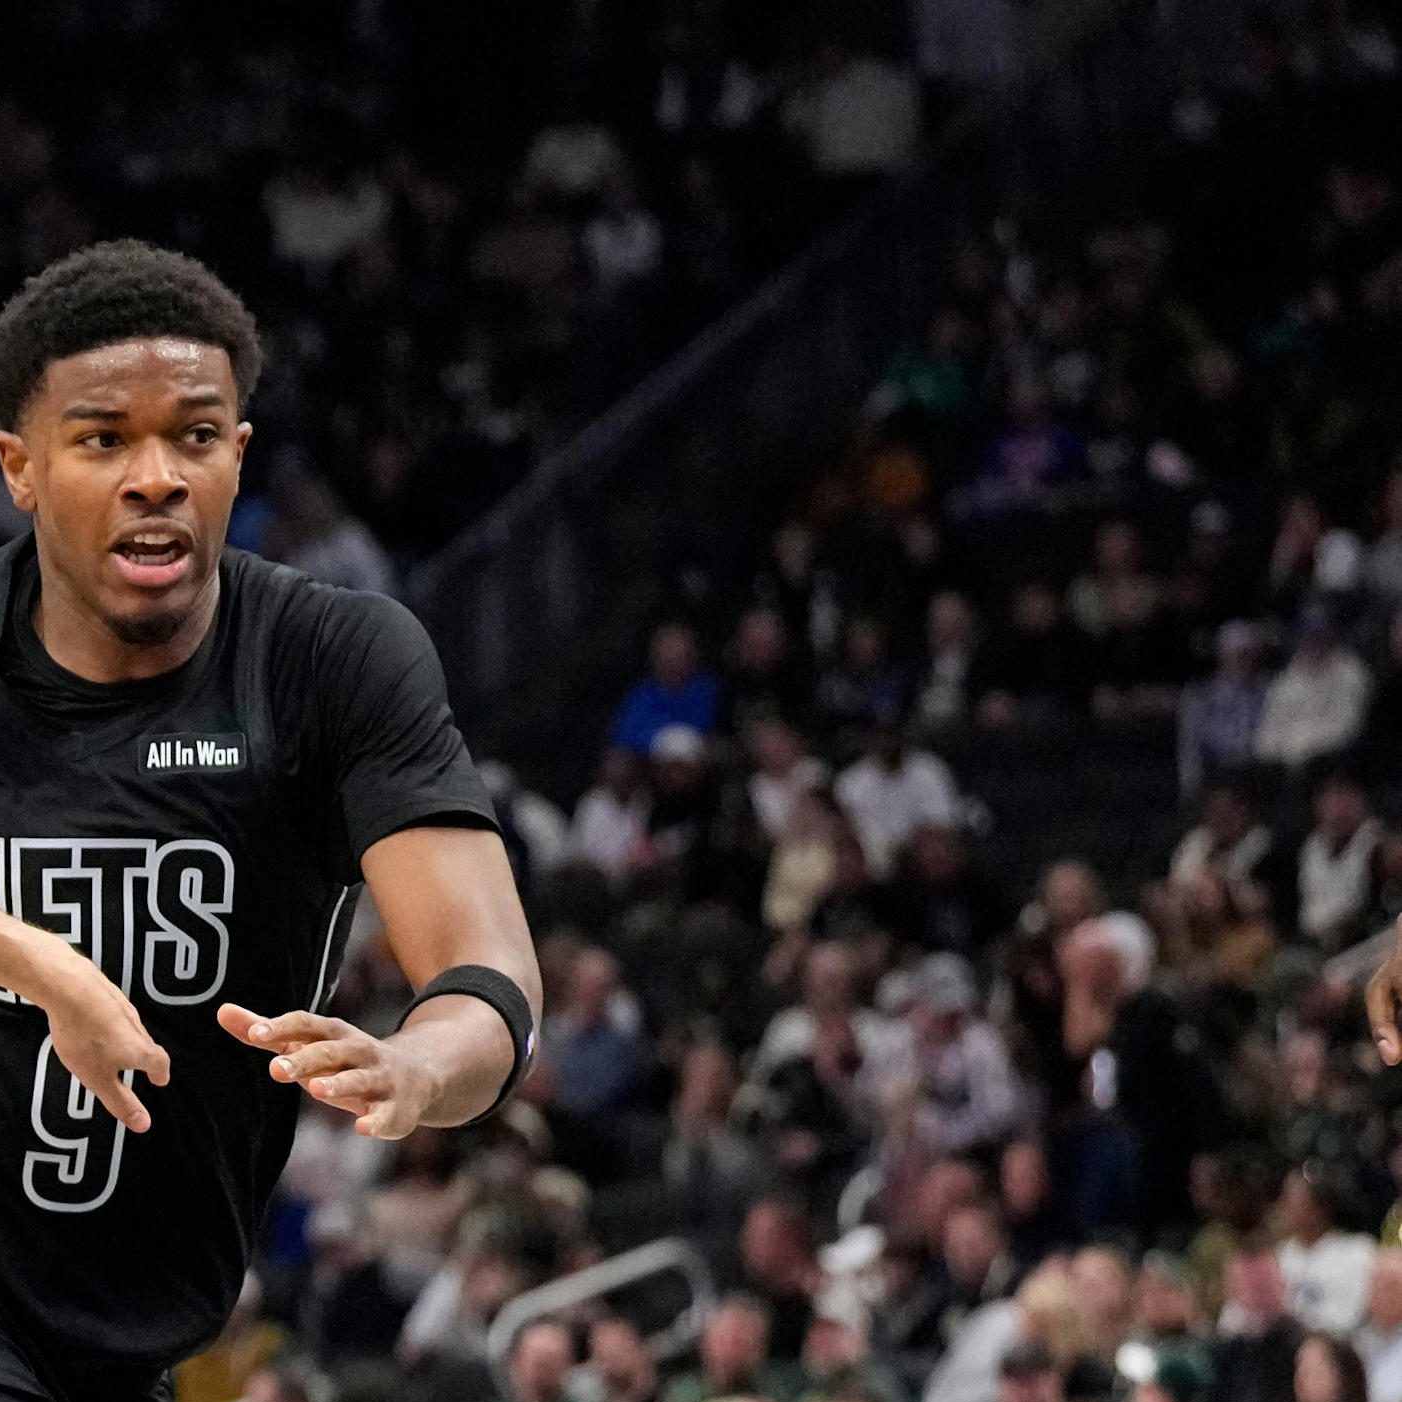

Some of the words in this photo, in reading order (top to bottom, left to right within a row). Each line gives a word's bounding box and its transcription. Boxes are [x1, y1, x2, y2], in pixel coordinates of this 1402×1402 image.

[146, 741, 172, 769] All
[175, 740, 194, 767] In
[196, 740, 239, 767] Won
[22, 1032, 135, 1213] 9
